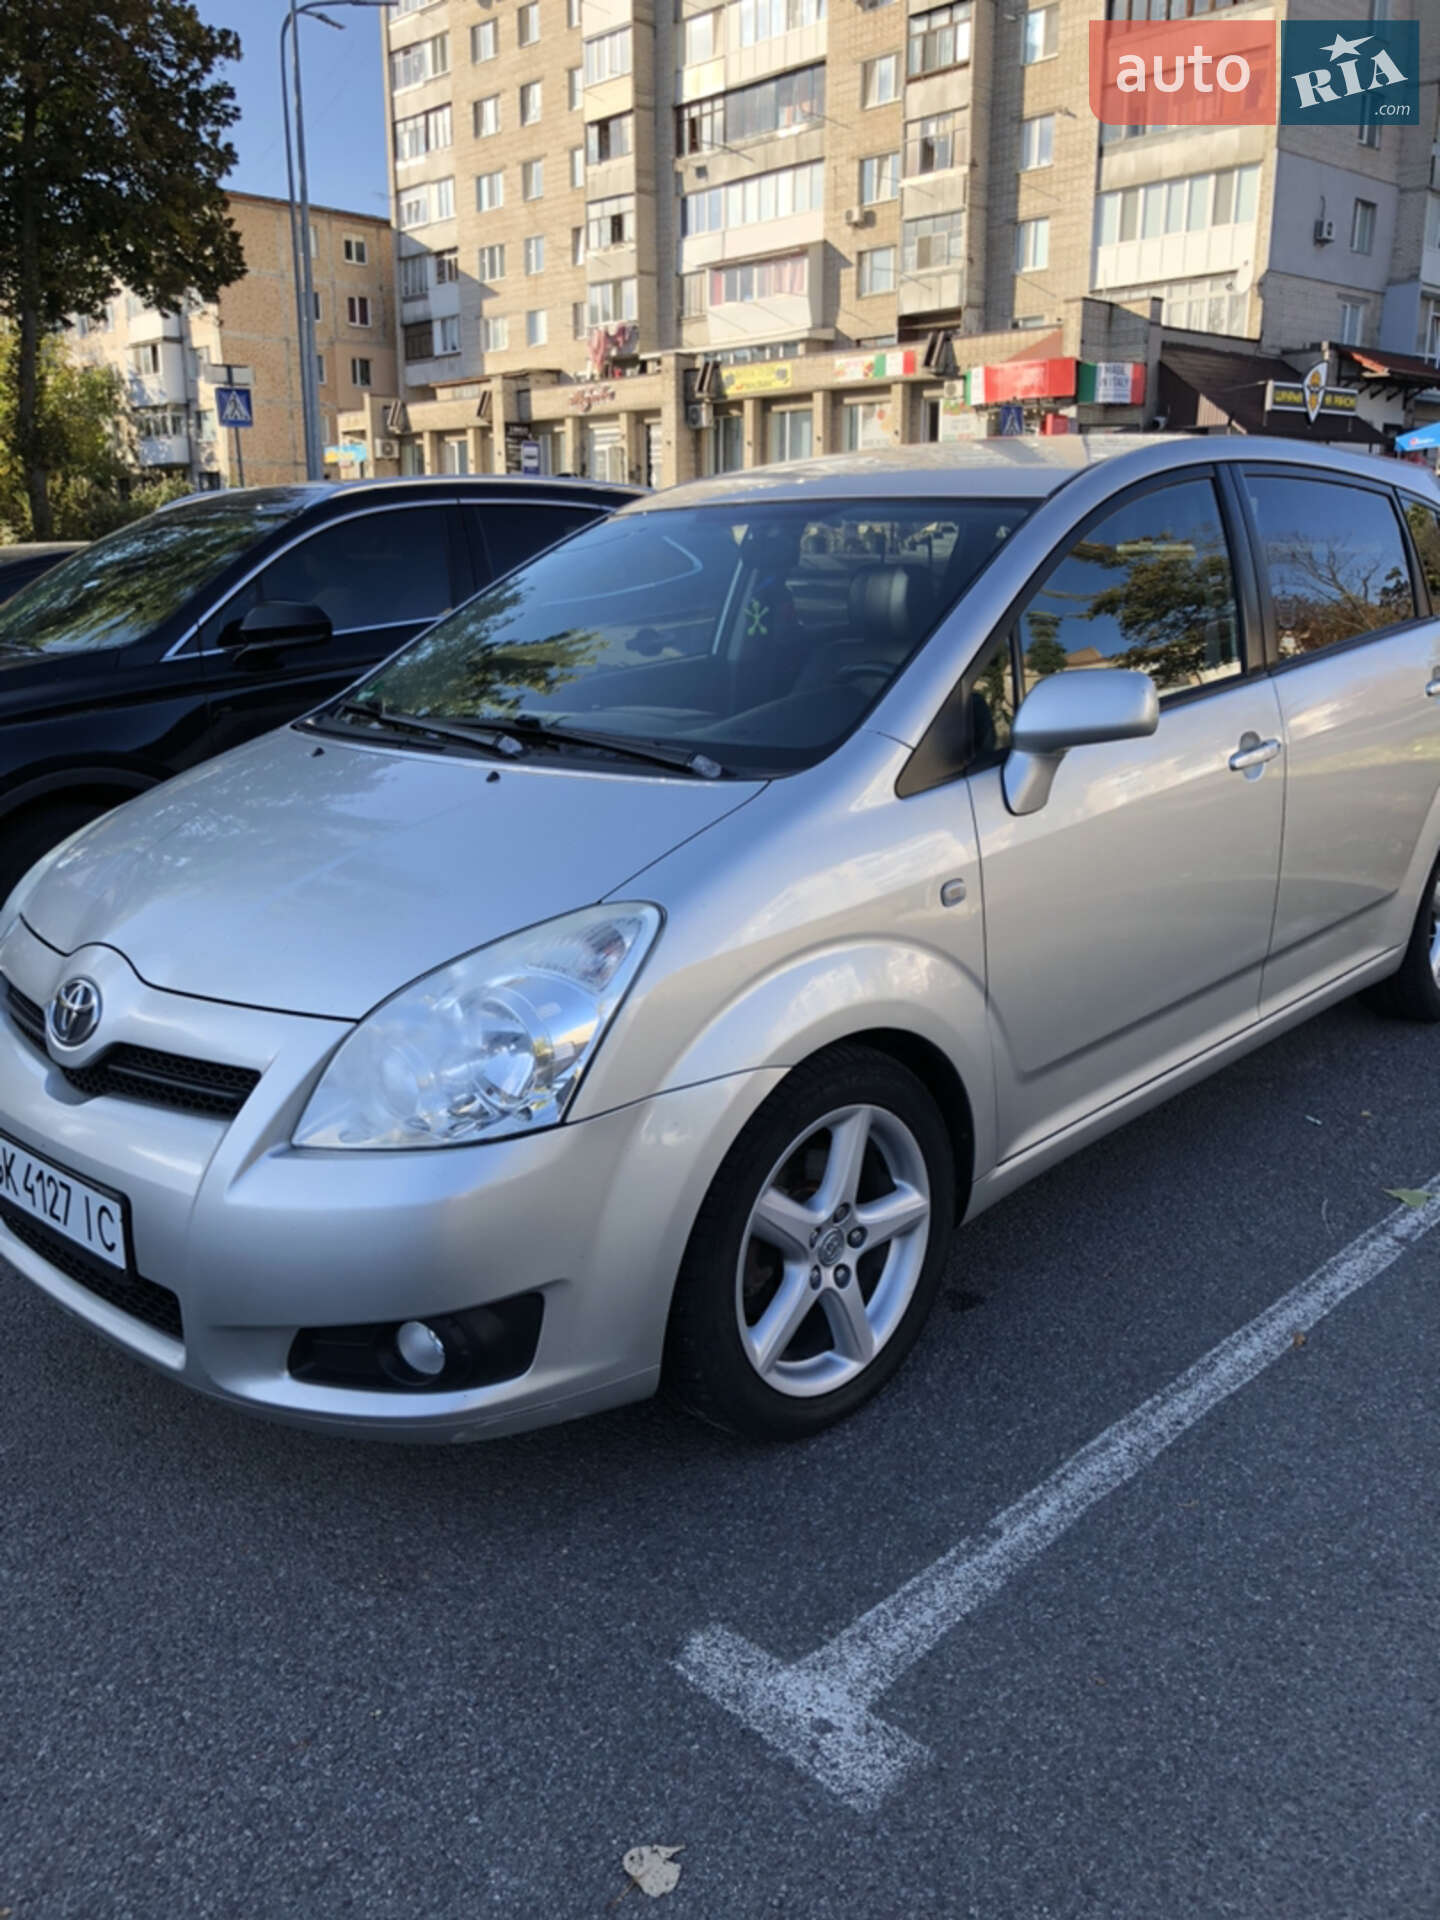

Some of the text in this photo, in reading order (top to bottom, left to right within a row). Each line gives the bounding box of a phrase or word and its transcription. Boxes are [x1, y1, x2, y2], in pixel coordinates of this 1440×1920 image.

[0, 1147, 116, 1252] K 4127 IC
